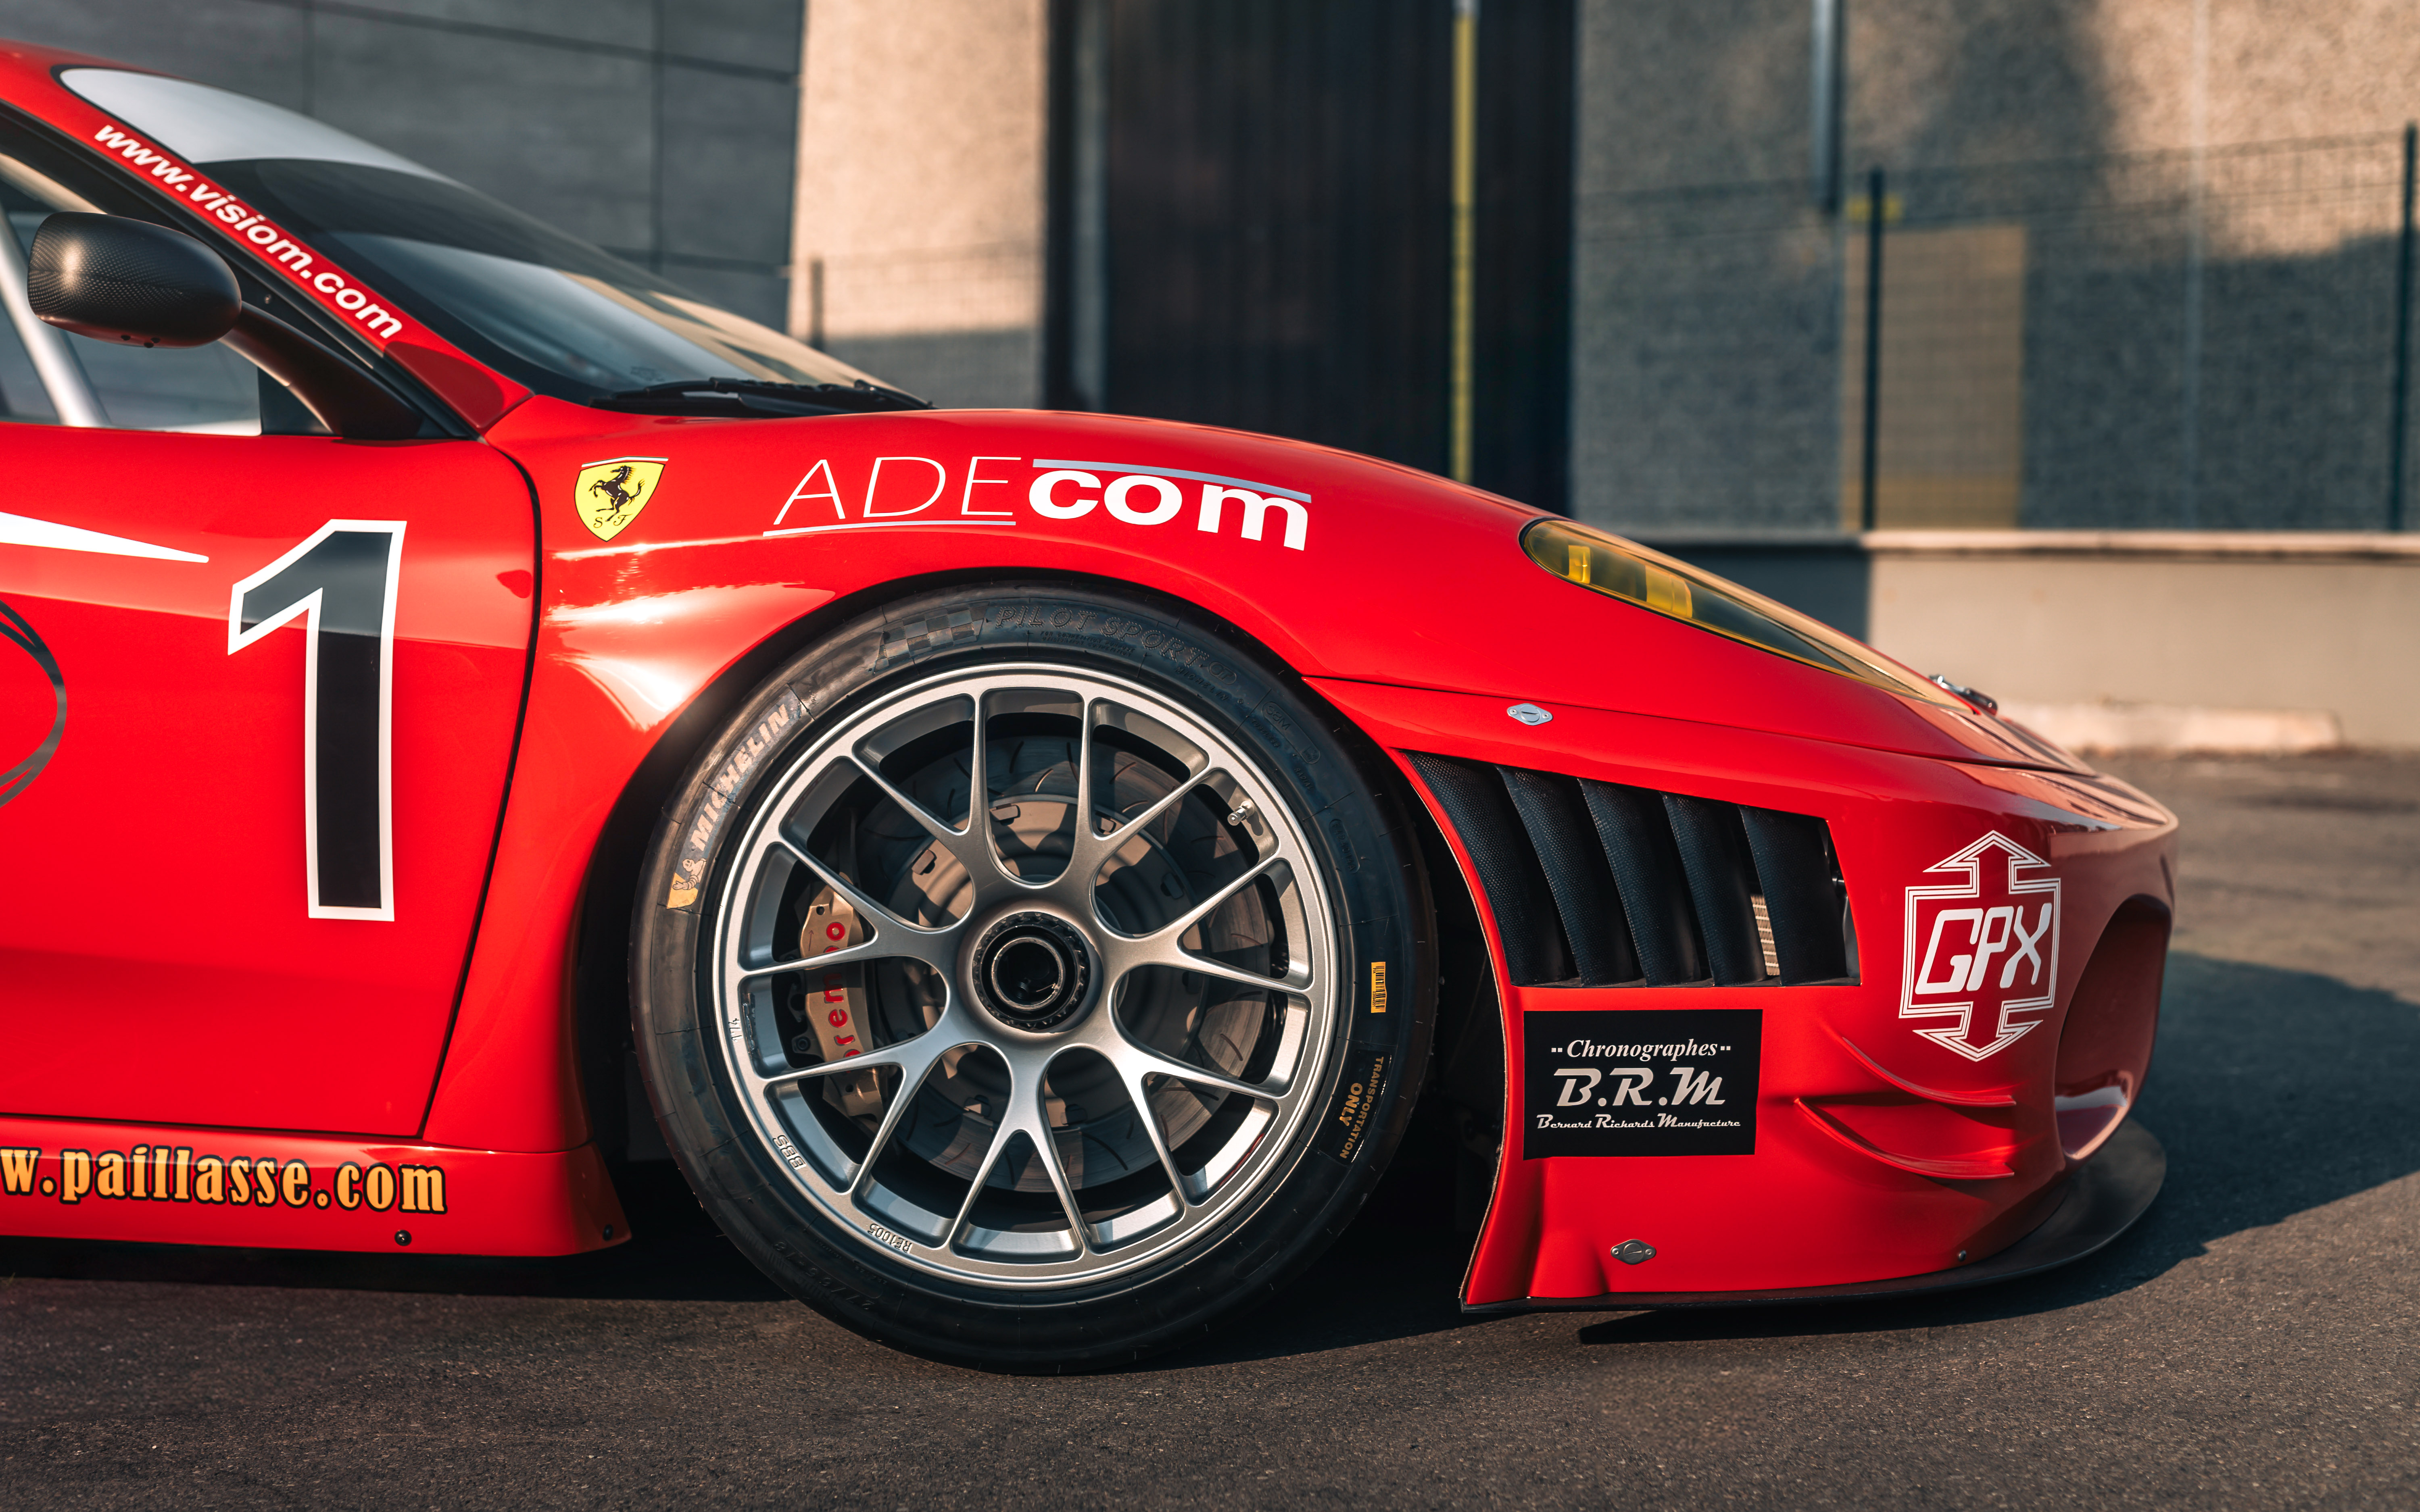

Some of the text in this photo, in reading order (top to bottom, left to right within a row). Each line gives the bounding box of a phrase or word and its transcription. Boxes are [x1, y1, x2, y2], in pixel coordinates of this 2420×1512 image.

[94, 125, 403, 339] www.visiom.com
[593, 517, 603, 528] S
[995, 606, 1098, 631] PILOT
[1099, 616, 1210, 668] SPORT
[1174, 666, 1229, 701] MICHELIN
[228, 519, 407, 922] 1
[690, 704, 791, 852] MICHELIN
[1294, 767, 1313, 790] RADIAL
[1915, 902, 2053, 995] GPX
[1567, 1039, 1717, 1061] Chronographes
[1339, 1083, 1363, 1126] ONLY
[1339, 1056, 1384, 1158] TRANSPORTATION
[1554, 1067, 1725, 1107] B.R.M
[1536, 1113, 1741, 1129] Bernard Richards Manufacture
[772, 1134, 807, 1170] BBS
[867, 1223, 913, 1254] RE1005
